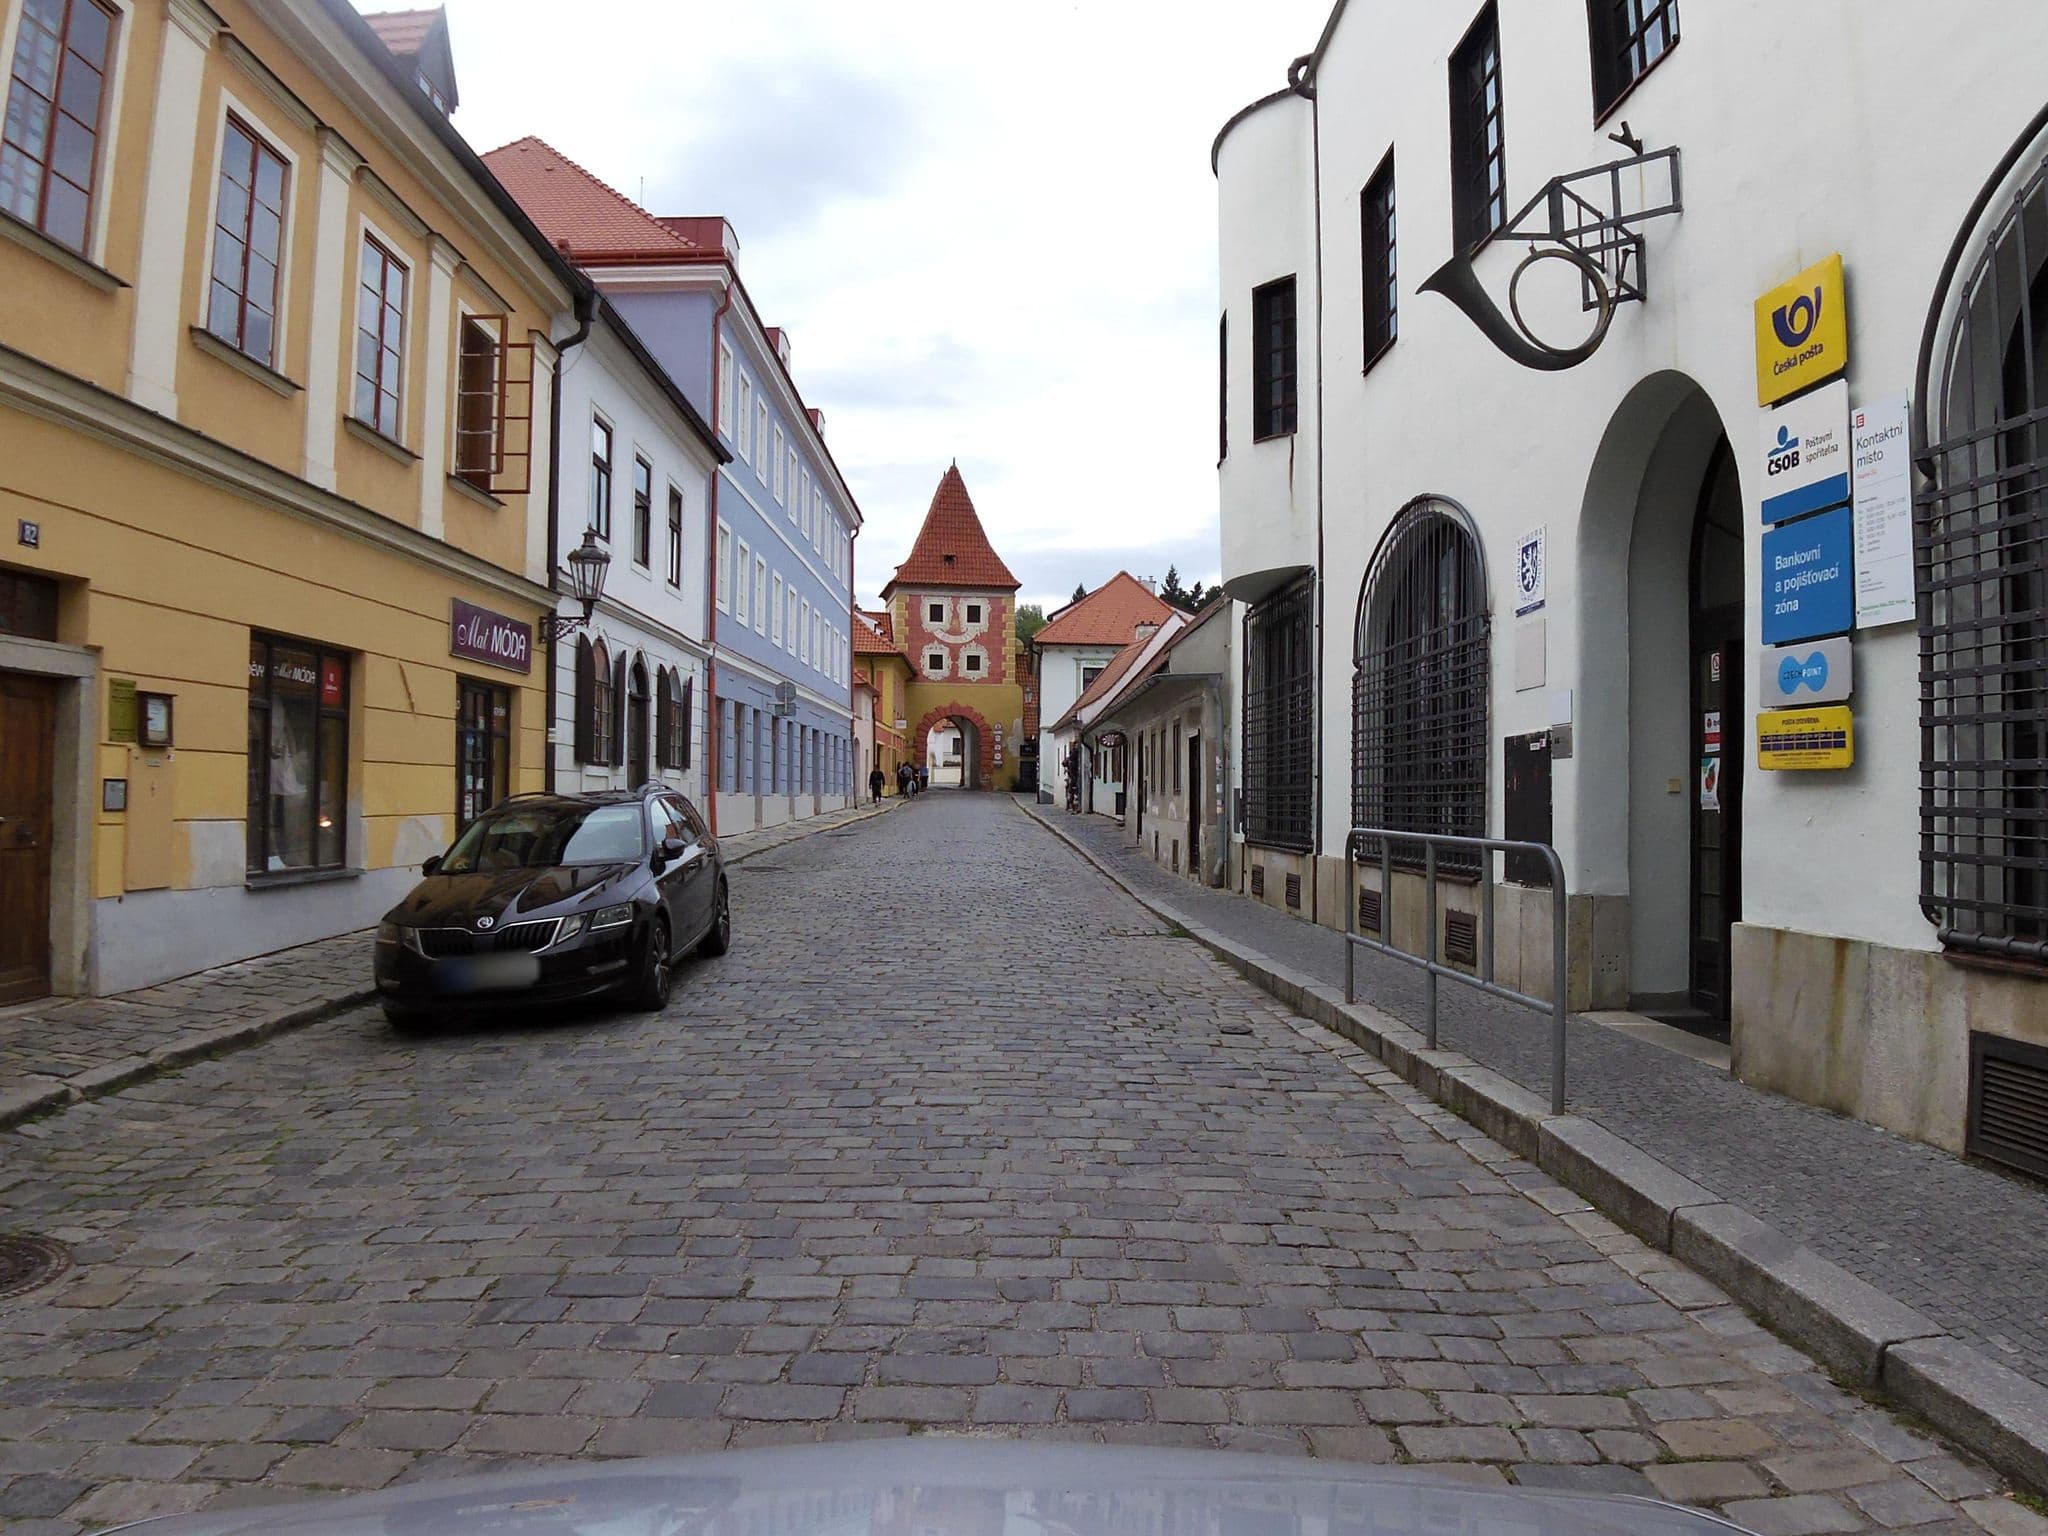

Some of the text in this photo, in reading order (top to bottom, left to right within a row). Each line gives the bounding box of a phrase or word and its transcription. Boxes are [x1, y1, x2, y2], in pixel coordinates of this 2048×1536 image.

[1773, 343, 1824, 376] Česká pošta
[1805, 429, 1833, 449] Poštovní
[1856, 420, 1903, 451] Kontaktní
[1767, 450, 1800, 476] ČSOB
[1805, 444, 1839, 464] spořitelna
[1856, 450, 1884, 469] místo
[1775, 543, 1822, 571] Bankovní
[1775, 580, 1782, 593] a
[1784, 561, 1840, 594] pojišťovací
[1775, 599, 1800, 615] zóna
[457, 614, 527, 662] Mat MÓDA
[292, 665, 316, 685] MÓDA
